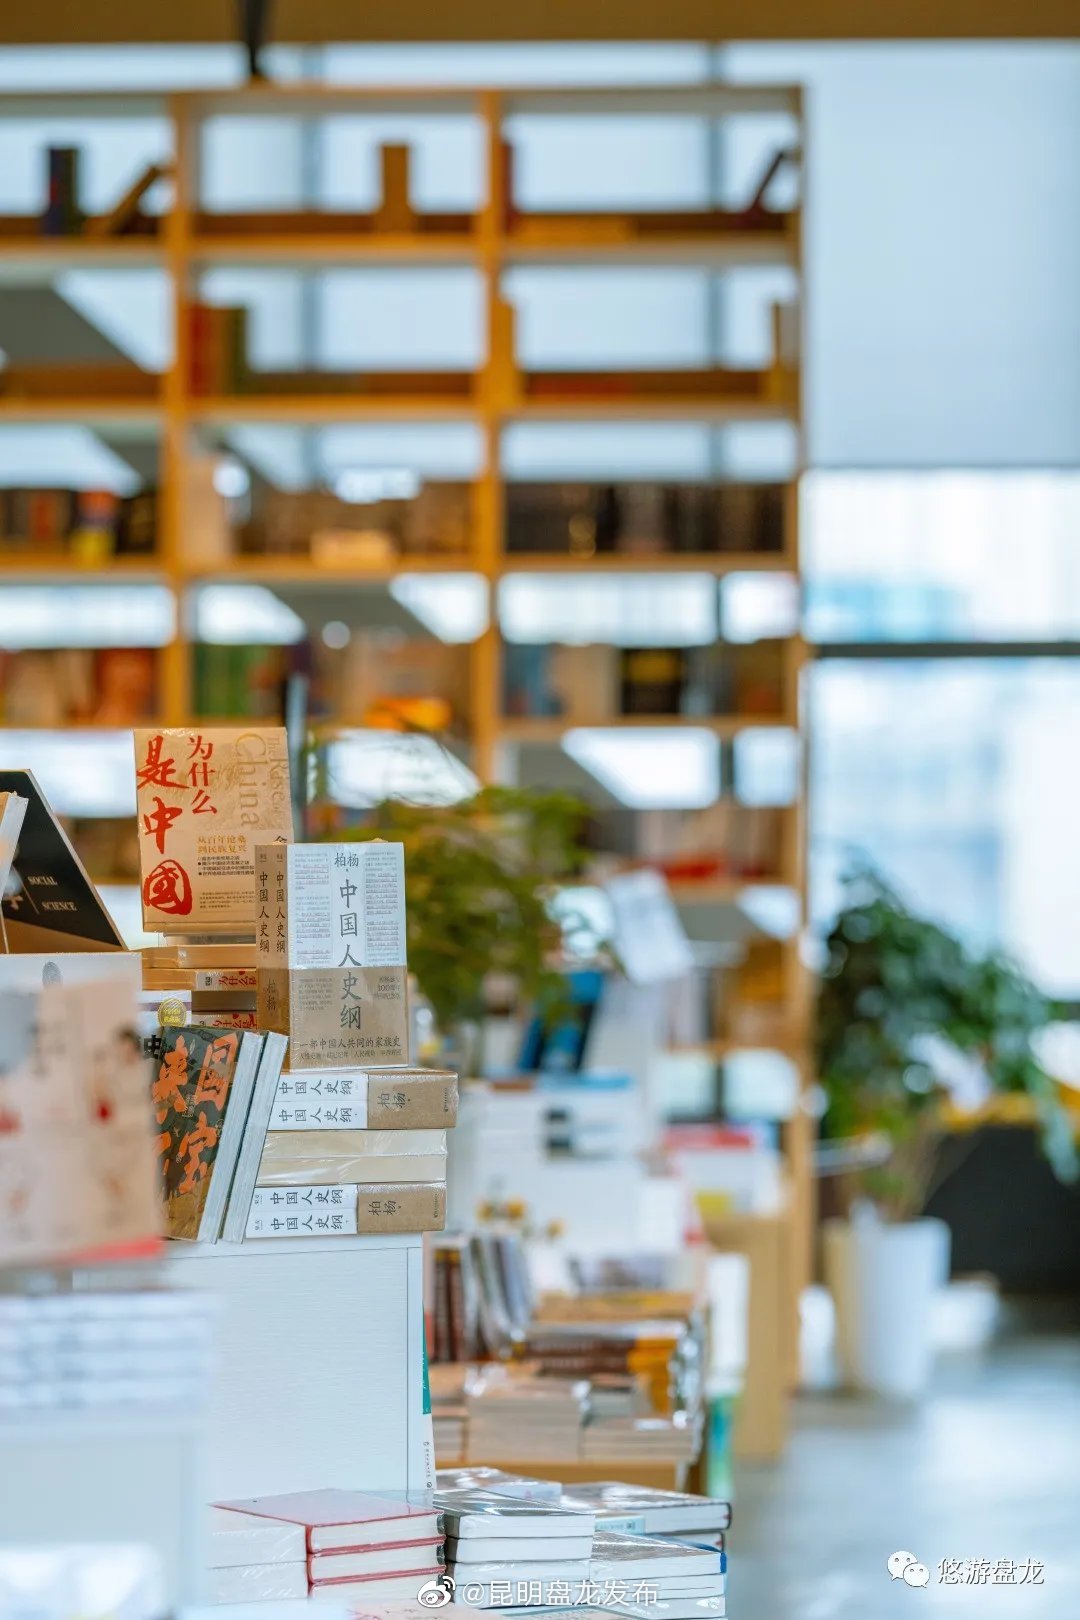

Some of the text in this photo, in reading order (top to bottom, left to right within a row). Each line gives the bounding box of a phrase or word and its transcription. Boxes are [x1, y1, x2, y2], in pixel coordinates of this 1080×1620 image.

[188, 735, 218, 814] 为什么
[235, 733, 268, 826] China
[334, 852, 359, 867] 柏杨
[27, 876, 57, 886] SOCIAL
[42, 902, 78, 912] SCIENCE
[259, 871, 269, 953] 中国人史纲
[276, 871, 286, 953] 中国人史纲
[338, 878, 362, 1031] 中国人史纲
[300, 1036, 401, 1050] 一部中国人共同的家族史
[279, 1079, 353, 1095] 中国人史纲
[377, 1092, 406, 1109] 柏杨
[279, 1107, 352, 1123] 中国人史纲
[270, 1189, 344, 1205] 中国人史纲
[368, 1200, 397, 1216] 柏杨
[271, 1214, 344, 1231] 中国人史纲
